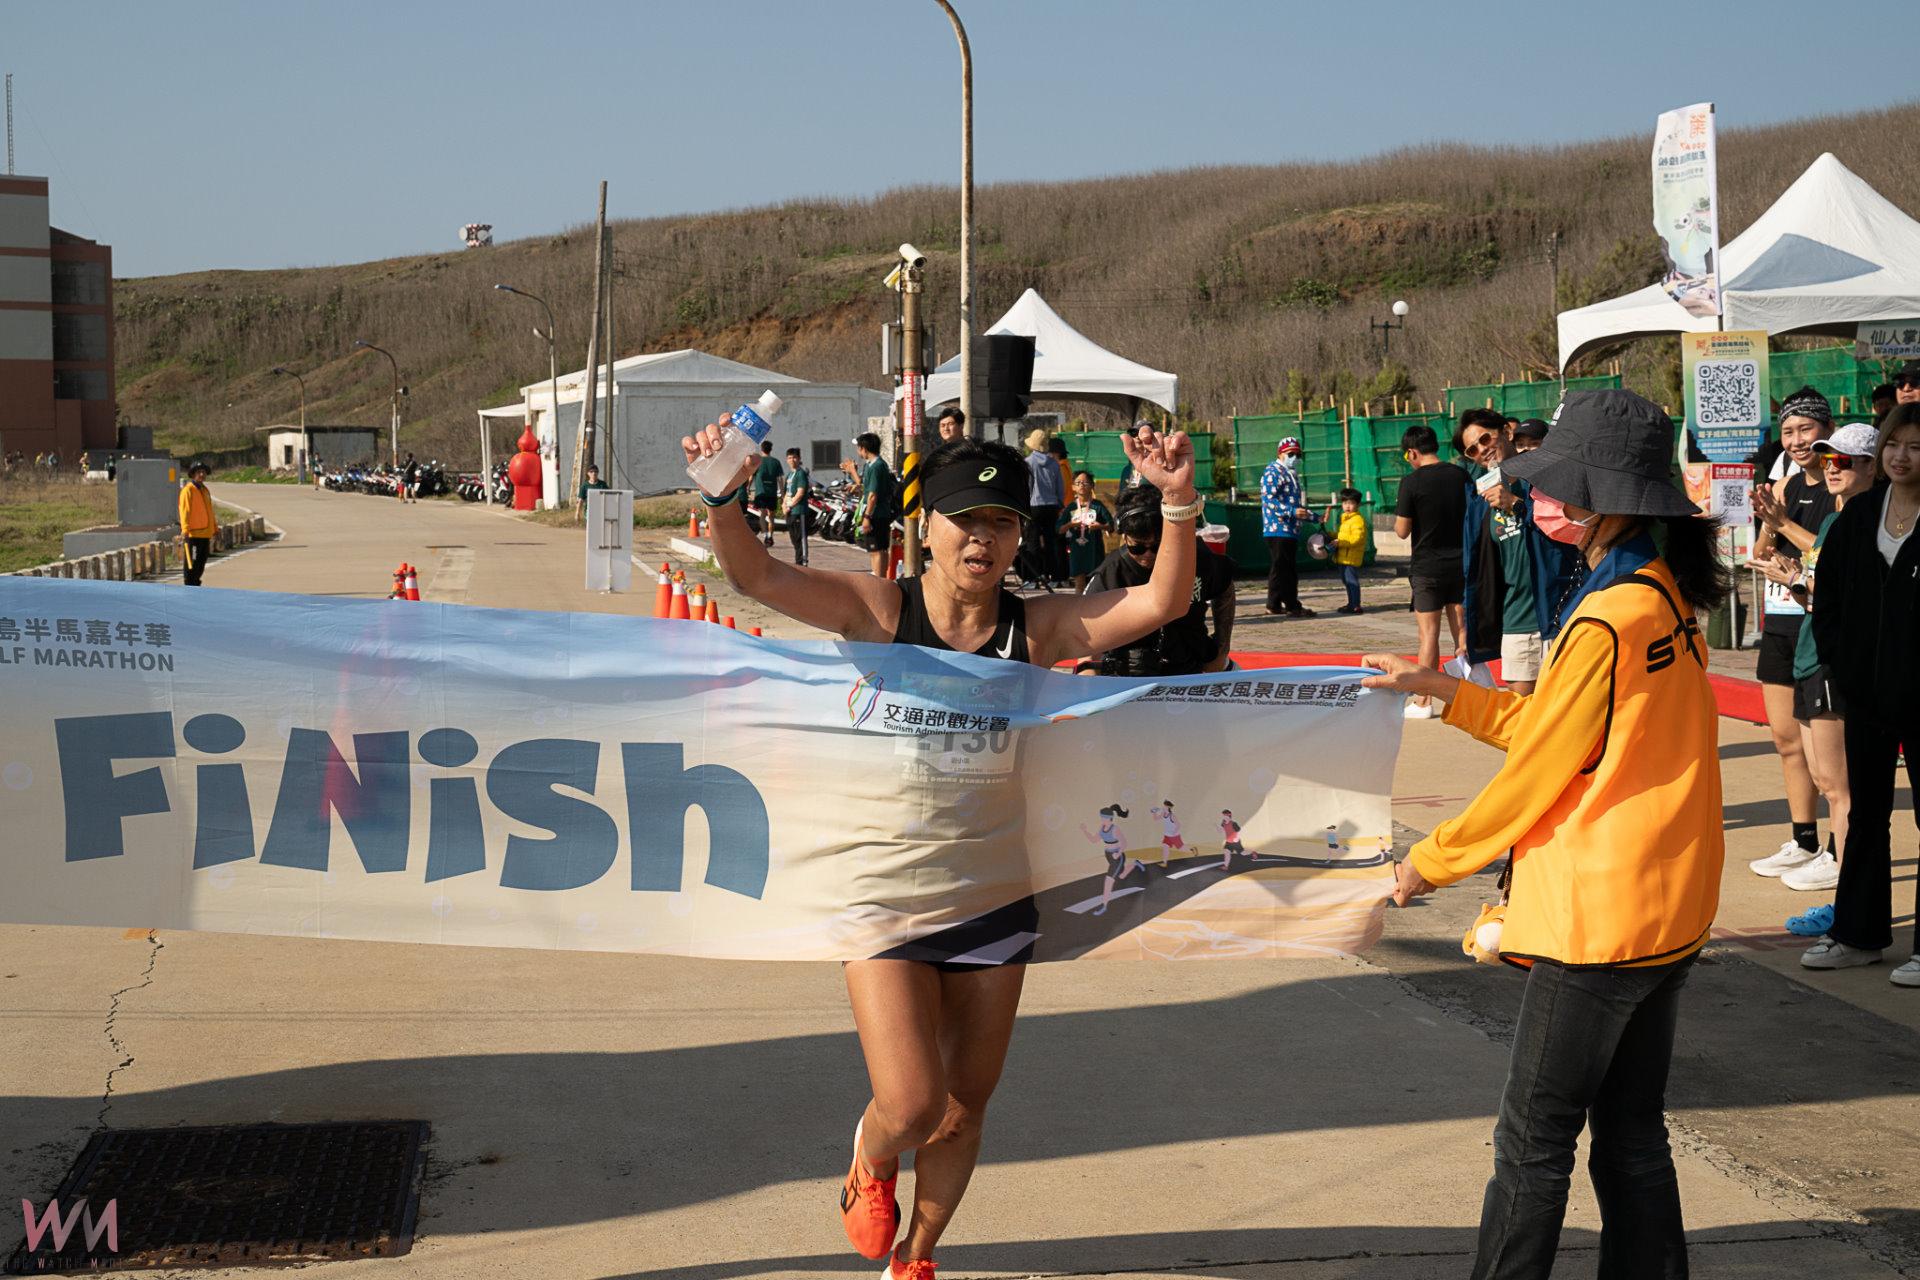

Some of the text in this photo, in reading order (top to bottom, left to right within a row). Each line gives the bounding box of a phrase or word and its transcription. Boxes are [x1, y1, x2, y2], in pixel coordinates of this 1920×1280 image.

[1871, 329, 1920, 346] 仙人掌
[0, 616, 172, 648] 島半馬嘉年華
[34, 647, 174, 672] MARATHON
[883, 703, 1010, 732] 交通部觀光署
[883, 721, 914, 734] Tourism
